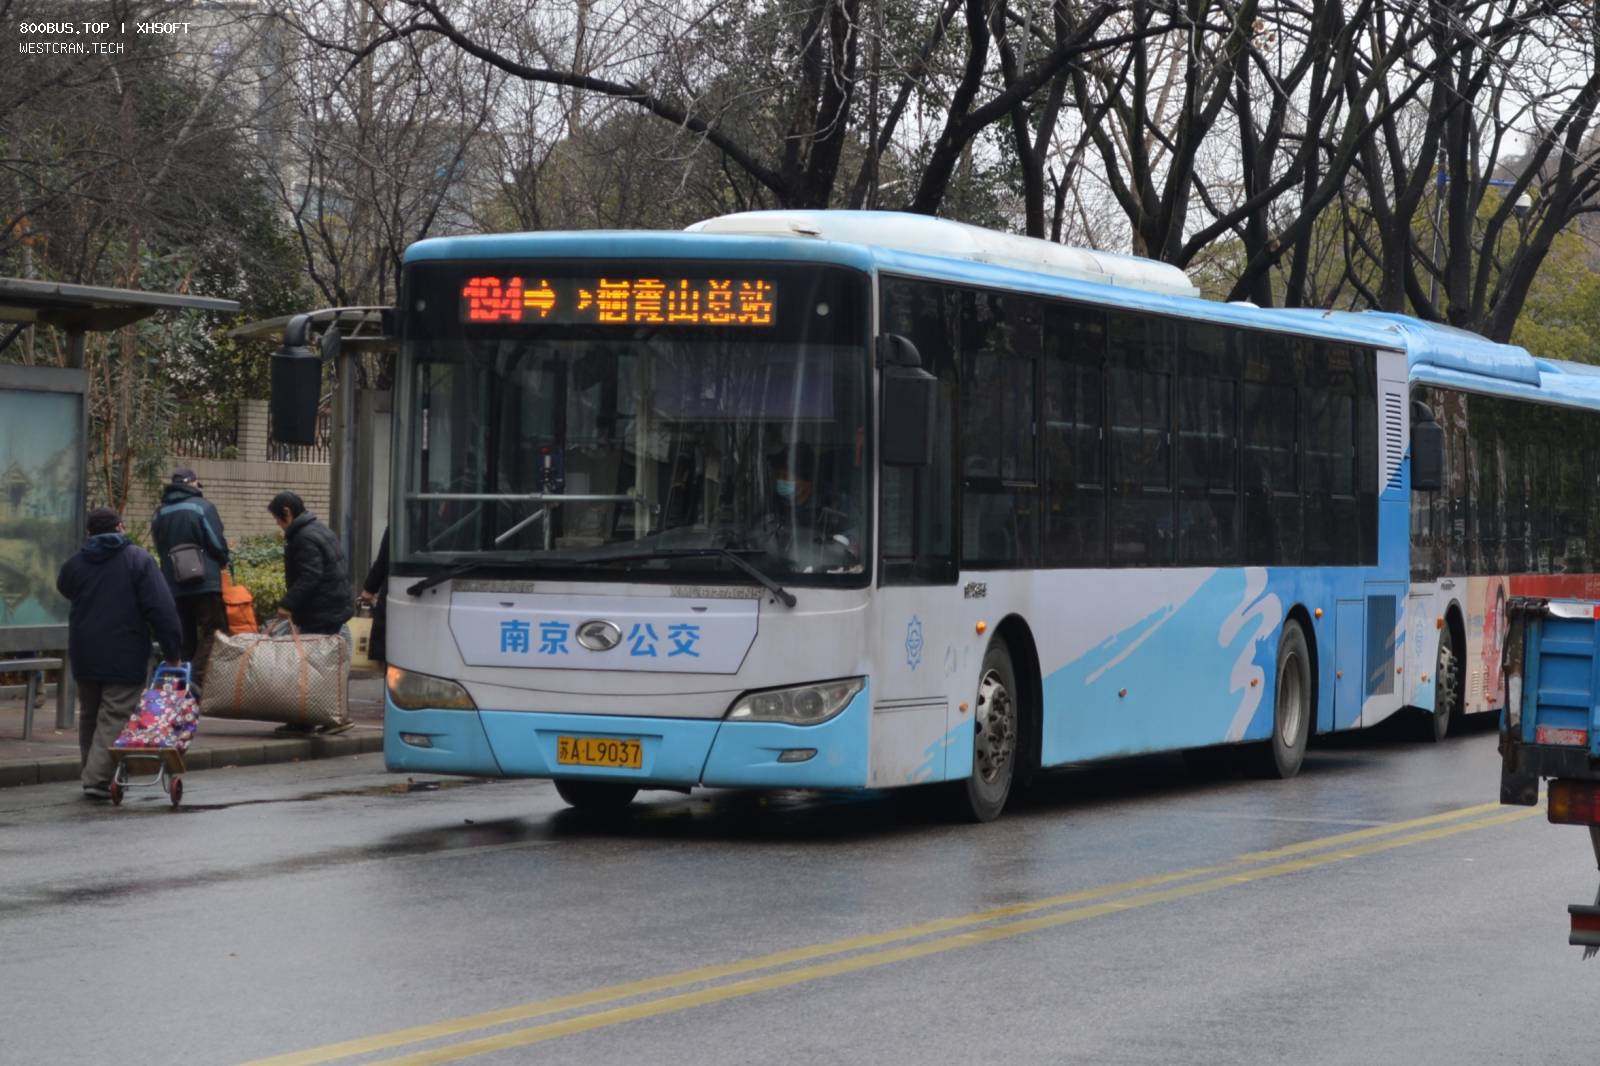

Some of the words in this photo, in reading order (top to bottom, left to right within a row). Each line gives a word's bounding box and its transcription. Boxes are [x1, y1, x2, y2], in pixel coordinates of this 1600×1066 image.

[463, 277, 522, 321] 194
[499, 619, 571, 656] 南京
[626, 623, 701, 658] 公交
